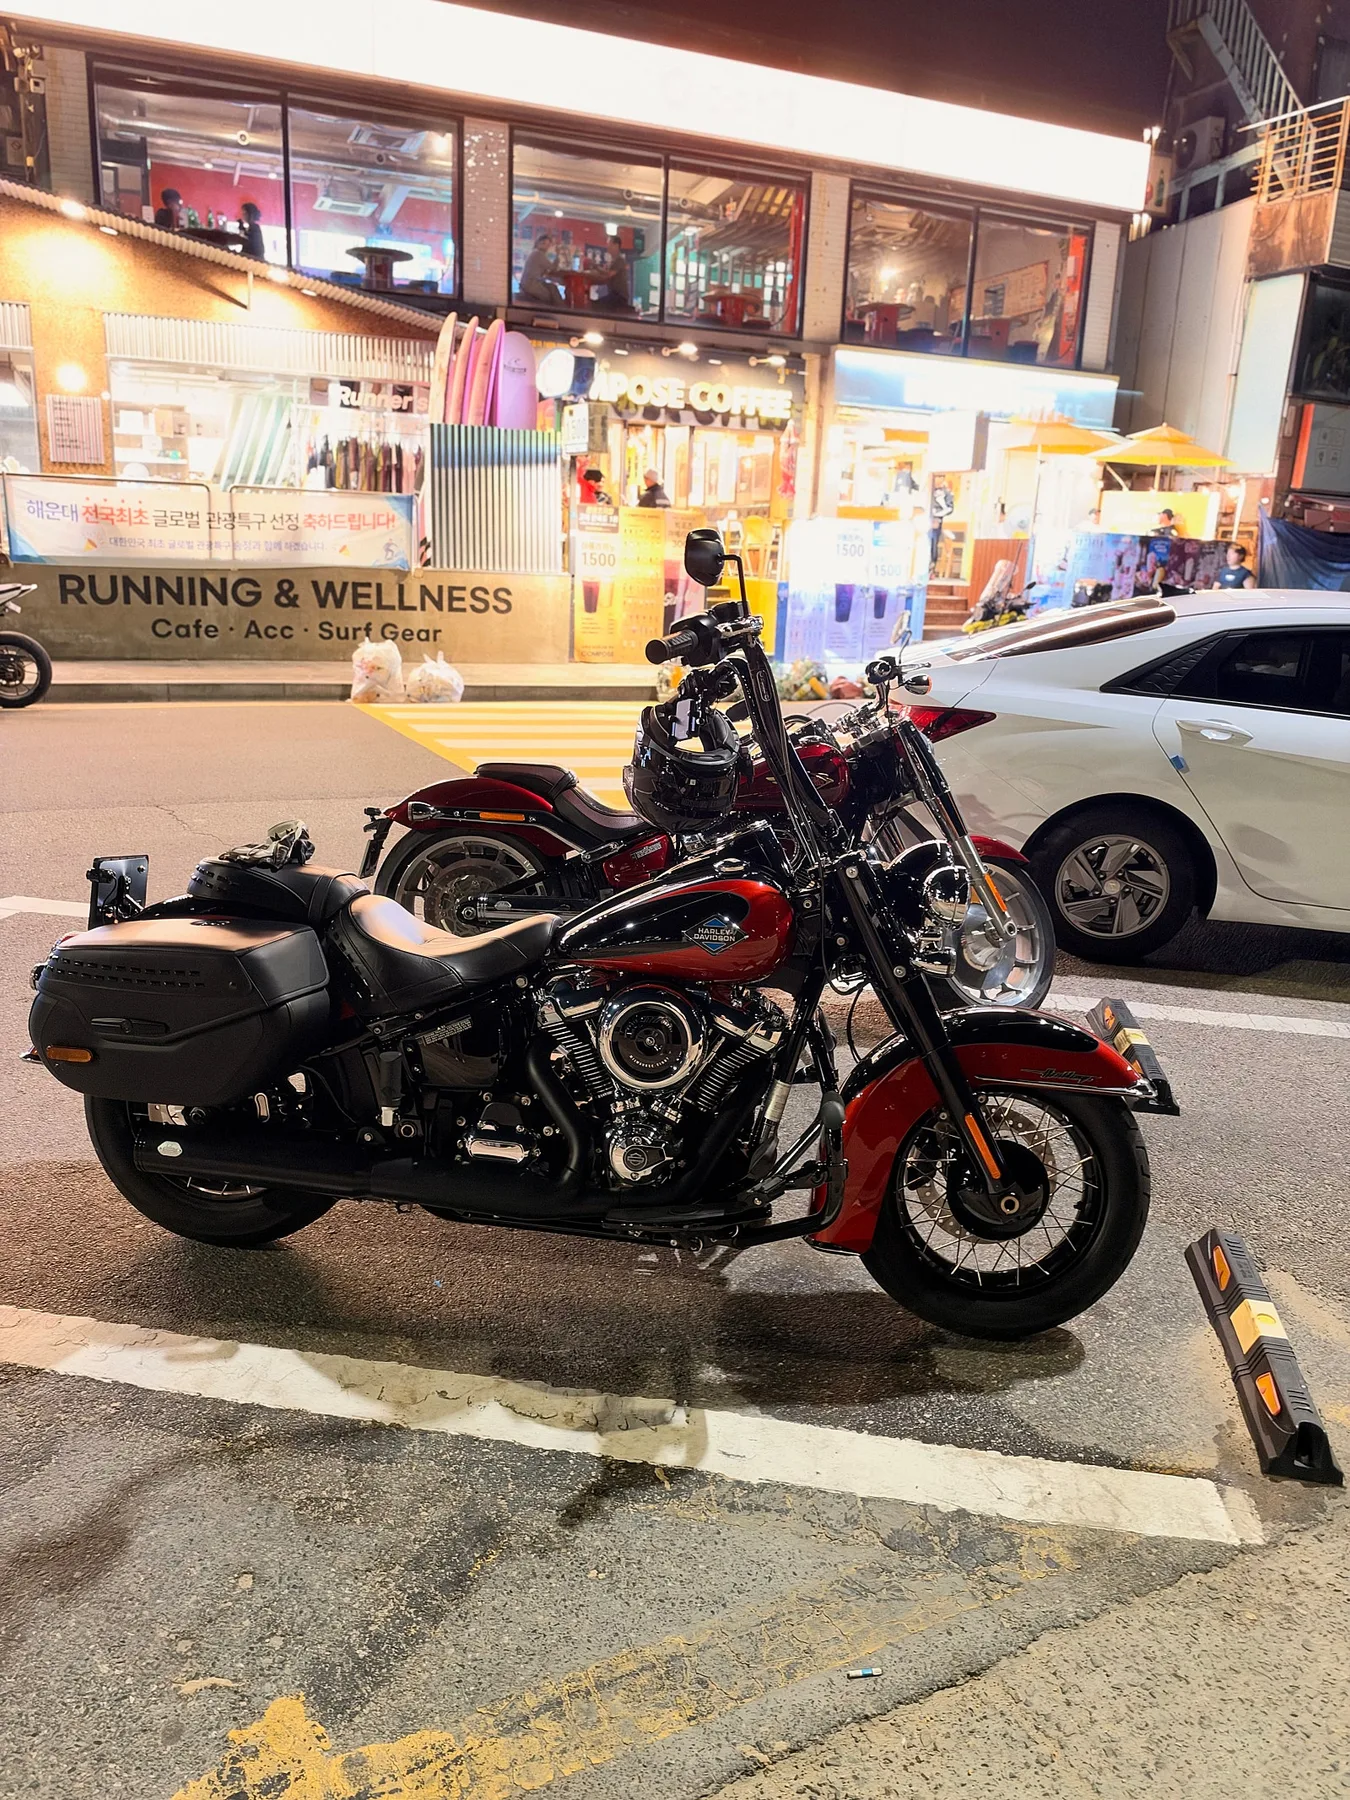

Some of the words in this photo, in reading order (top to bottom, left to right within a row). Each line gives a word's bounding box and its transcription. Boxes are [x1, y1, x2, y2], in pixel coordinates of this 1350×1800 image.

[689, 381, 793, 419] COFFEE
[27, 499, 79, 522] 해운대
[82, 503, 150, 527] 전국최초
[153, 508, 201, 530] 글로벌
[206, 511, 267, 531] 관광특구
[270, 512, 300, 532] 선정
[302, 511, 396, 531] 축하드립니다!
[108, 536, 146, 549] 대한민국
[836, 544, 865, 557] 1500
[582, 552, 616, 567] 1500
[874, 564, 902, 577] 1500
[58, 574, 263, 608] RUNNING
[274, 578, 301, 609] &
[311, 580, 513, 614] WELLNESS
[151, 618, 219, 639] Cafe
[244, 619, 294, 640] Acc
[318, 621, 373, 641] Surf
[380, 622, 442, 643] Gear
[693, 933, 736, 942] DAVIDSON
